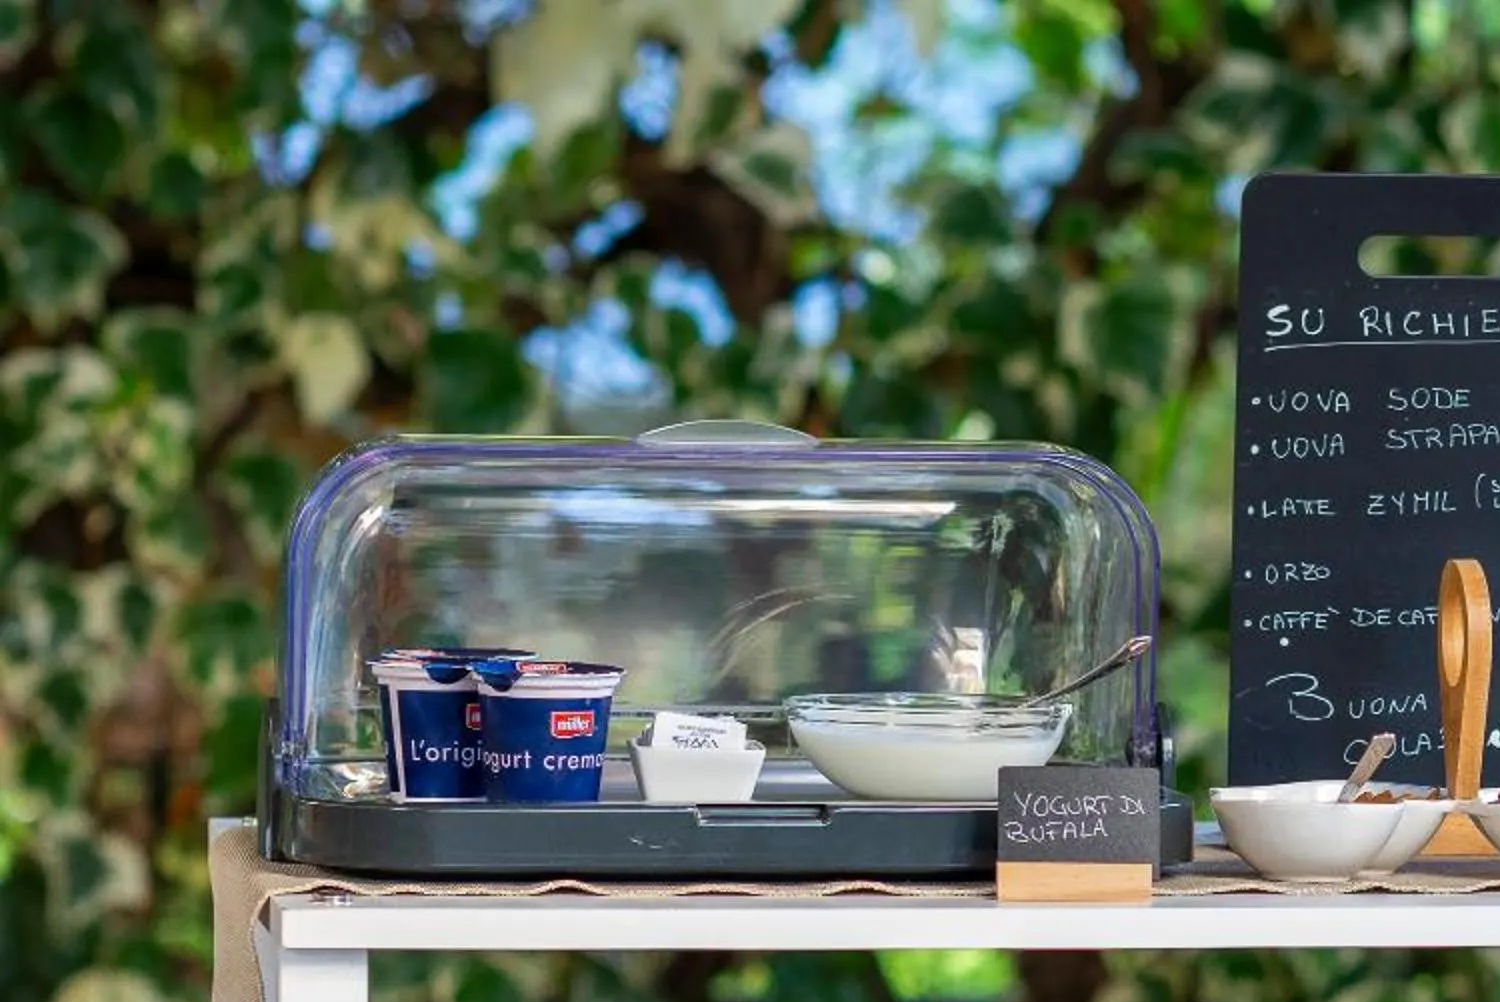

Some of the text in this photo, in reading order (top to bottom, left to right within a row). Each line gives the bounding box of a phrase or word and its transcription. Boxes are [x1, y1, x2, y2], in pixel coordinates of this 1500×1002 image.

[1265, 304, 1325, 337] SU
[1268, 386, 1472, 414] UOVA SODE
[1271, 433, 1346, 459] UOVA
[1366, 490, 1457, 516] ZYMIL
[1265, 563, 1332, 585] ORZO
[411, 739, 482, 769] L'origi
[483, 750, 532, 773] ogurt
[1013, 790, 1146, 817] YOGURT DI
[1004, 818, 1108, 843] BUFALA
